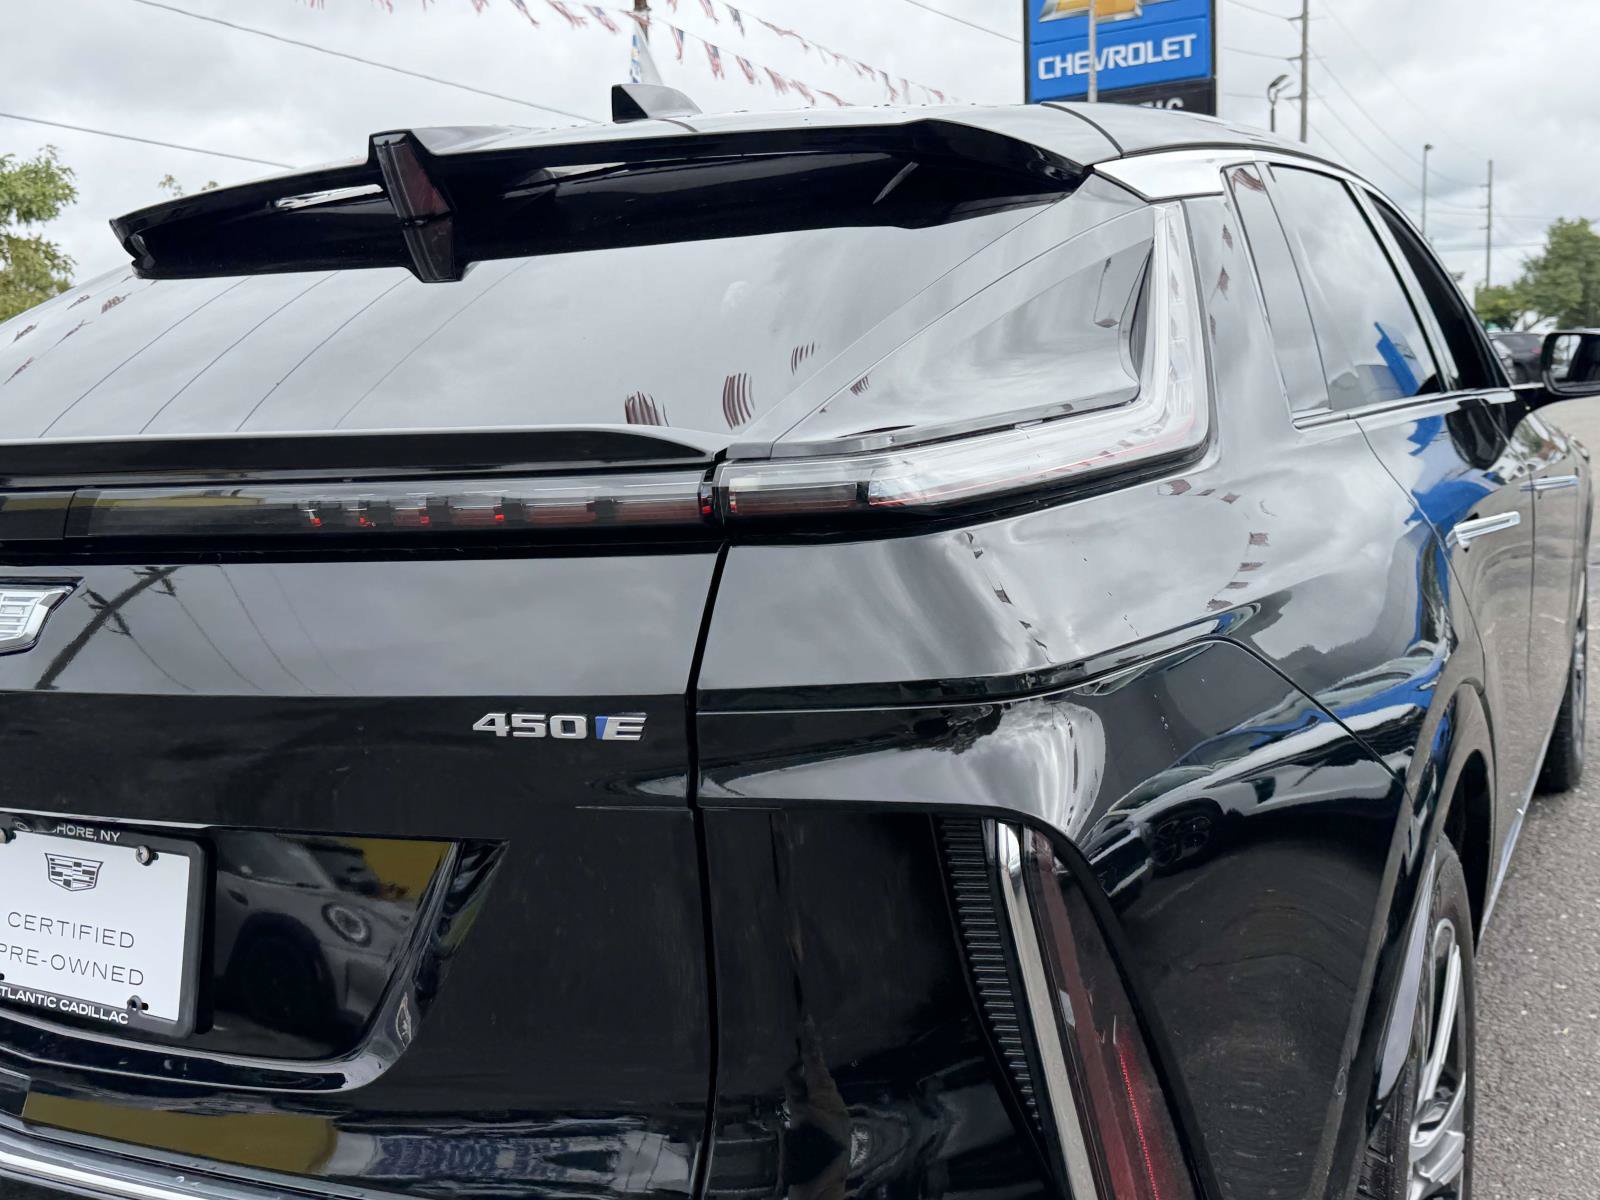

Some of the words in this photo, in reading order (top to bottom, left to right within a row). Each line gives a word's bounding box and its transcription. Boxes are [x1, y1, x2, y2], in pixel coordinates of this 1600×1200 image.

[1038, 34, 1197, 80] CHEVROLET
[52, 823, 98, 841] HORE,
[100, 829, 121, 843] NY
[7, 911, 135, 949] CERTIFIED
[0, 985, 57, 1008] TLANTIC
[59, 999, 129, 1025] CADILLAC
